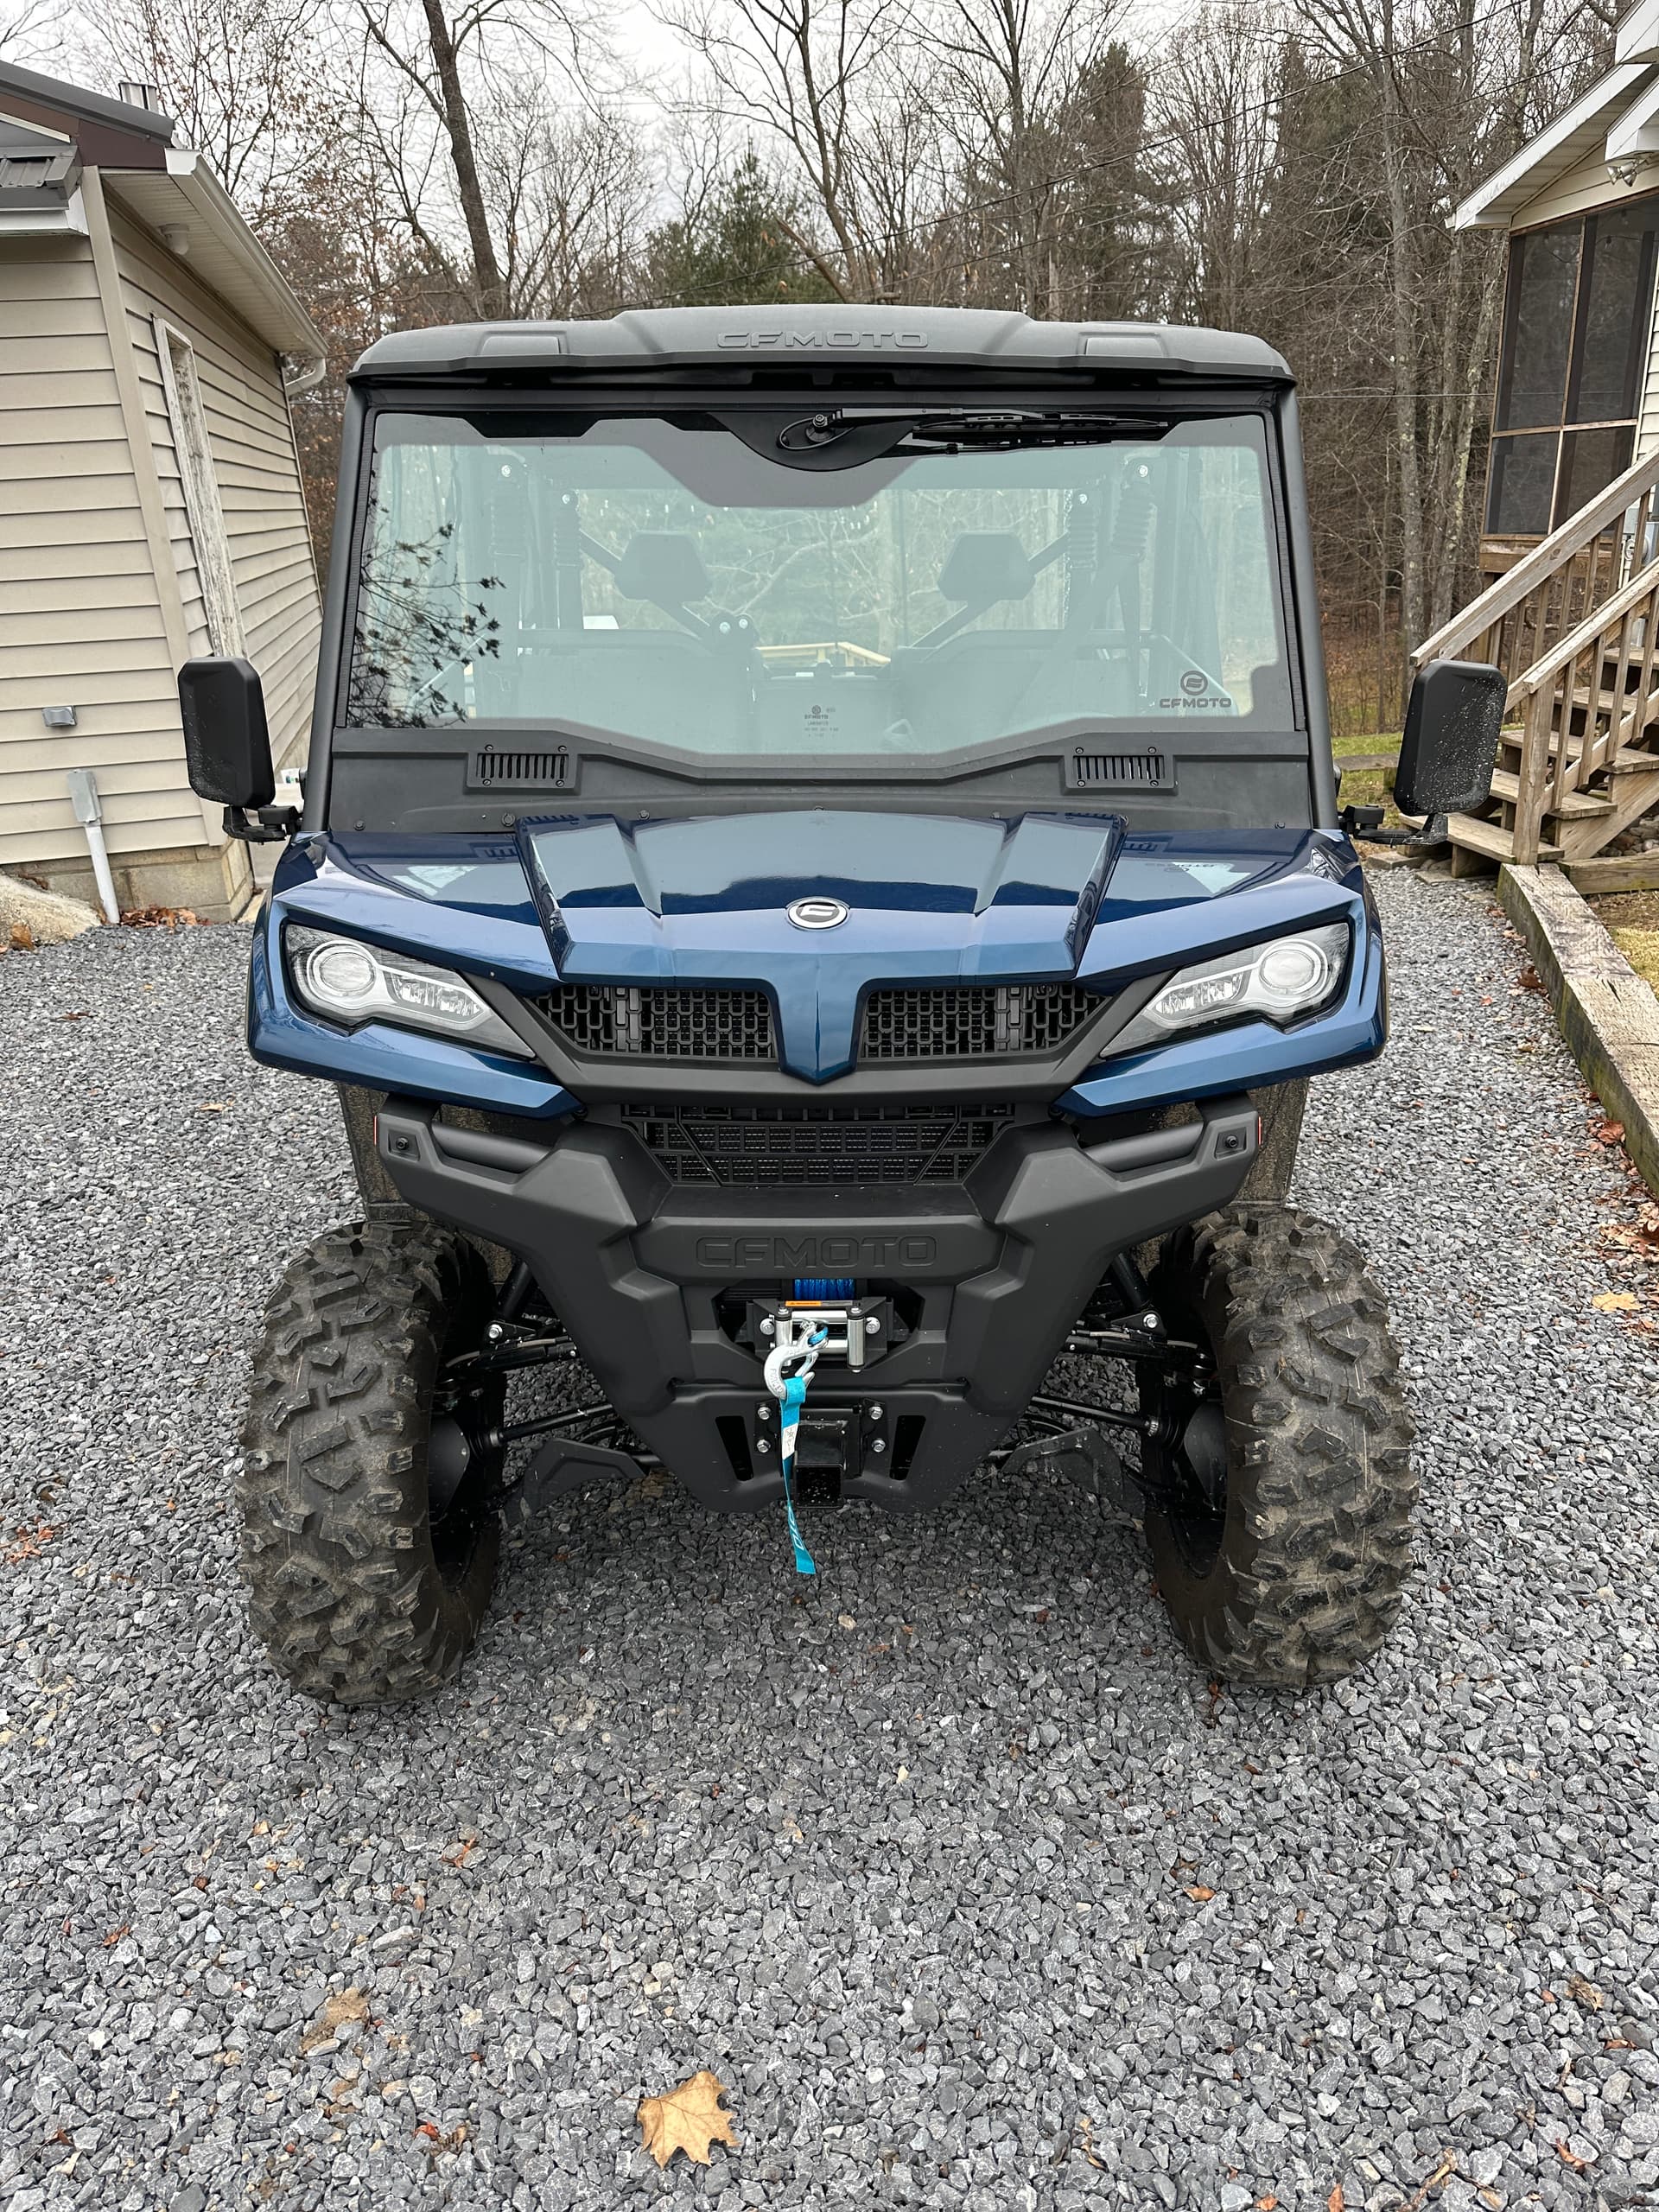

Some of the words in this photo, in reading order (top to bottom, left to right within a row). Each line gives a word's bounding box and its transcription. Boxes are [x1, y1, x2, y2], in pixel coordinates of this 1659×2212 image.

[717, 331, 928, 348] CFMOTO
[1159, 697, 1232, 709] CFMOTO
[696, 1236, 937, 1268] CFMOTO
